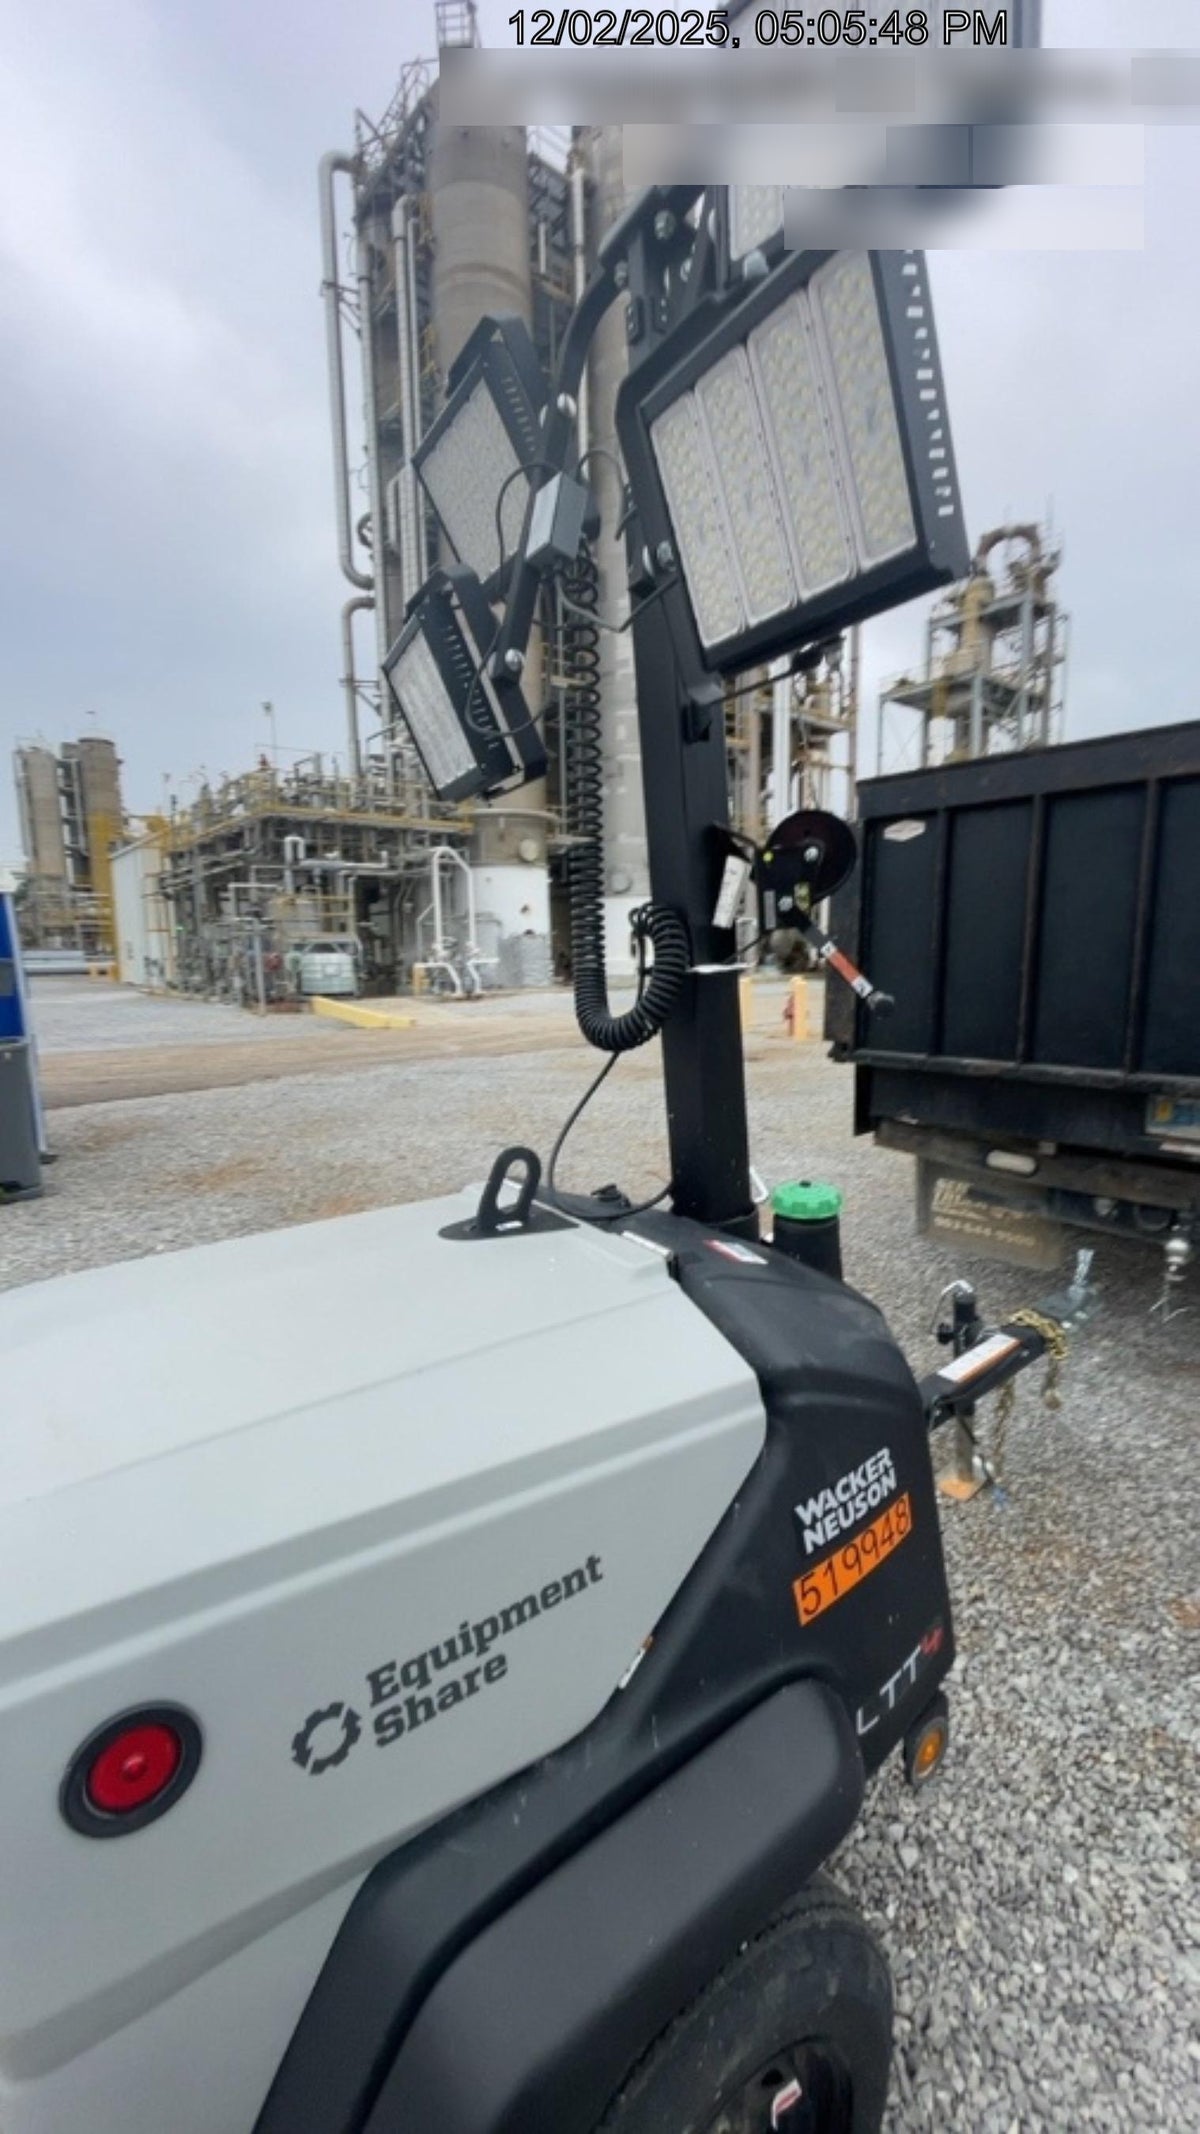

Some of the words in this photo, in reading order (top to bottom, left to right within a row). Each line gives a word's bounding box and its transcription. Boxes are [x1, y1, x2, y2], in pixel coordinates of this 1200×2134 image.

[795, 1447, 894, 1525] WACKER
[803, 1467, 897, 1555] NEUSON
[800, 1497, 908, 1615] 519948
[366, 1554, 603, 1708] Equipment
[373, 1652, 508, 1747] Share
